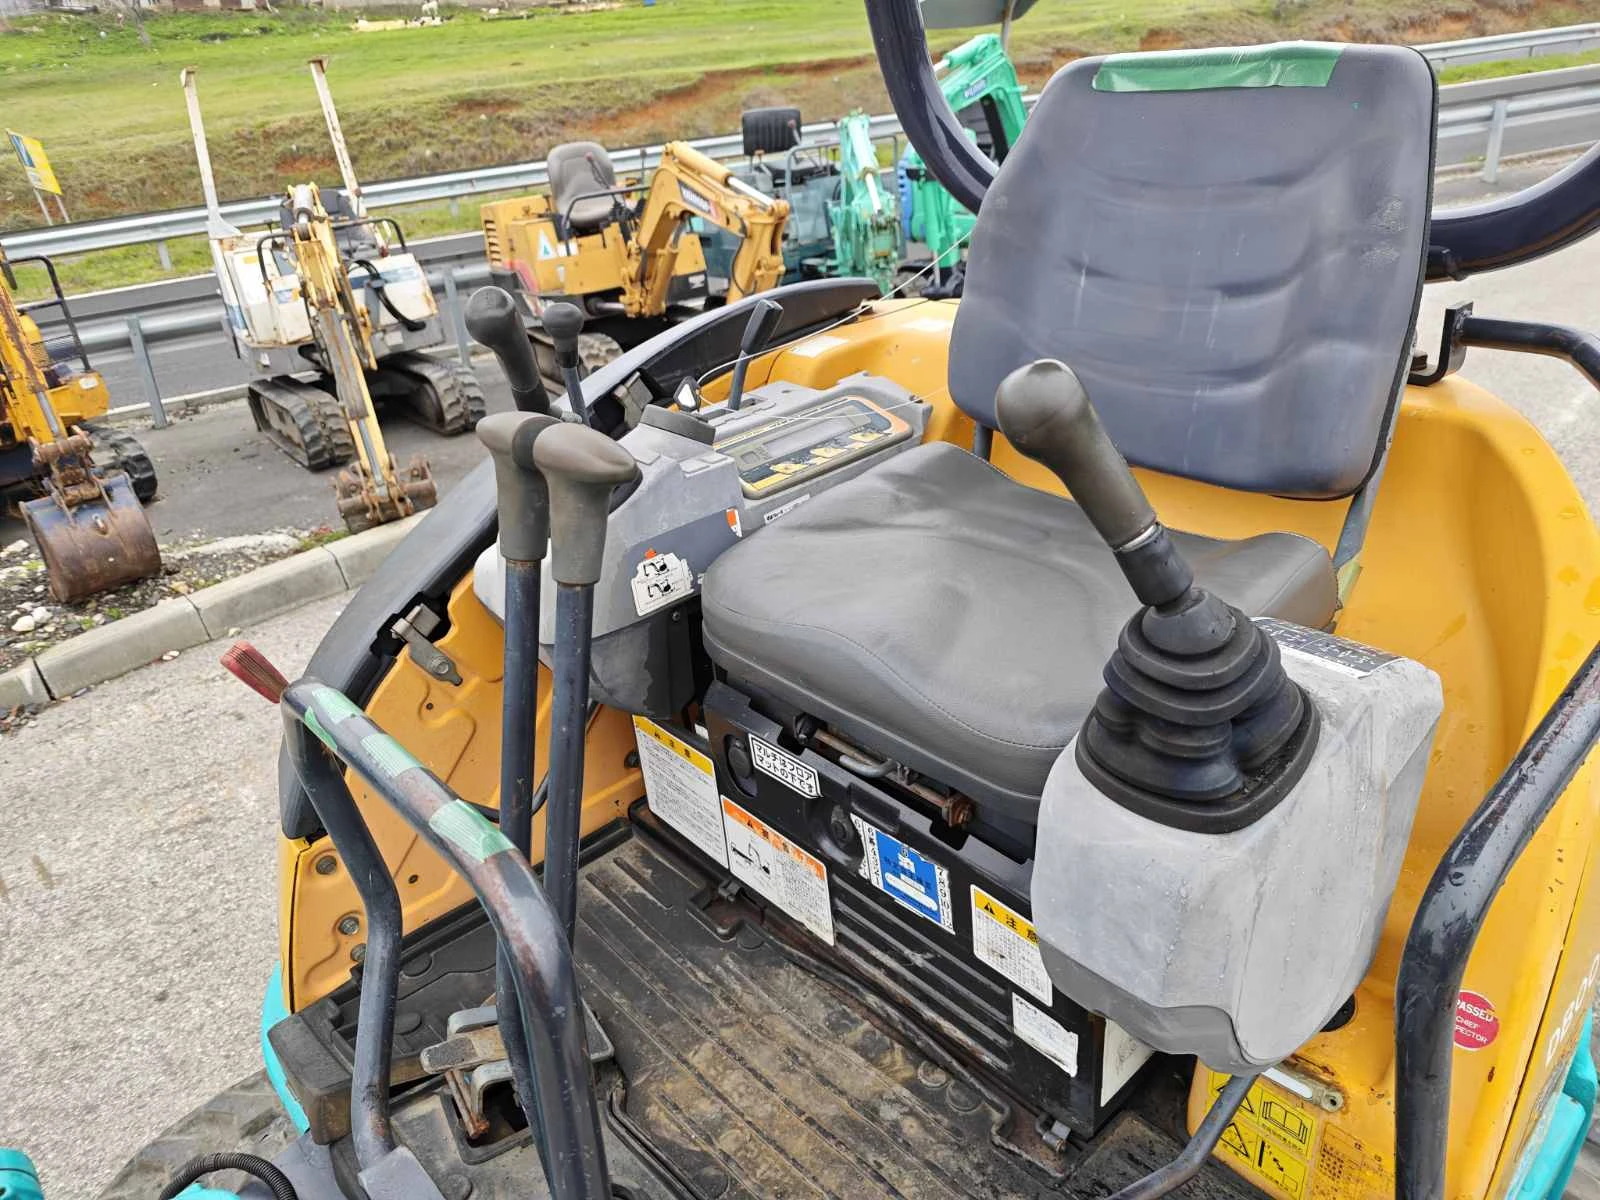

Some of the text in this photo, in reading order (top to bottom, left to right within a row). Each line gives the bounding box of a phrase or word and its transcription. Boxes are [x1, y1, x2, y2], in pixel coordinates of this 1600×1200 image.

[754, 743, 813, 781] マルチはフロア
[756, 754, 814, 793] マットの下です
[1455, 1025, 1488, 1044] PECTOR
